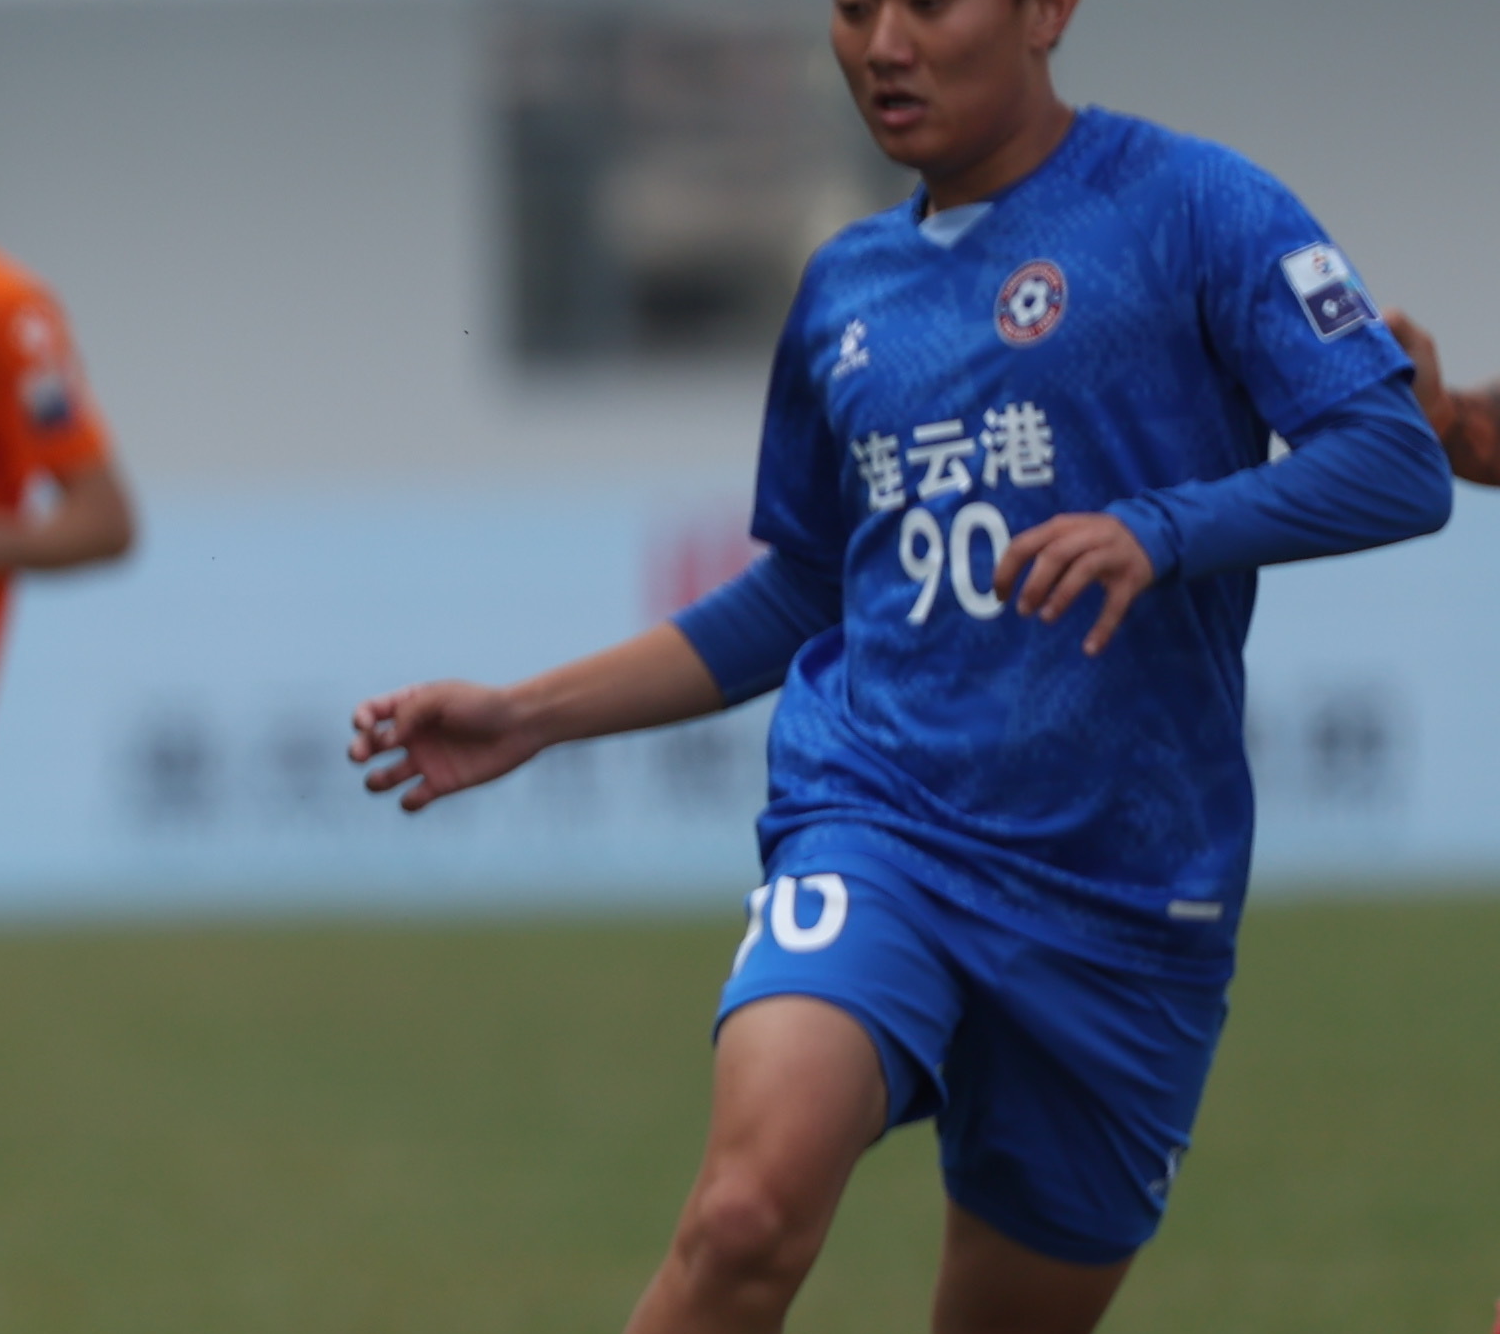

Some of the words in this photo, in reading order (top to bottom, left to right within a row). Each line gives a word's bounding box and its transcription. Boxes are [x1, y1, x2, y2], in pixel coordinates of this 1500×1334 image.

[852, 401, 1055, 512] 连云港
[900, 501, 1012, 626] 90
